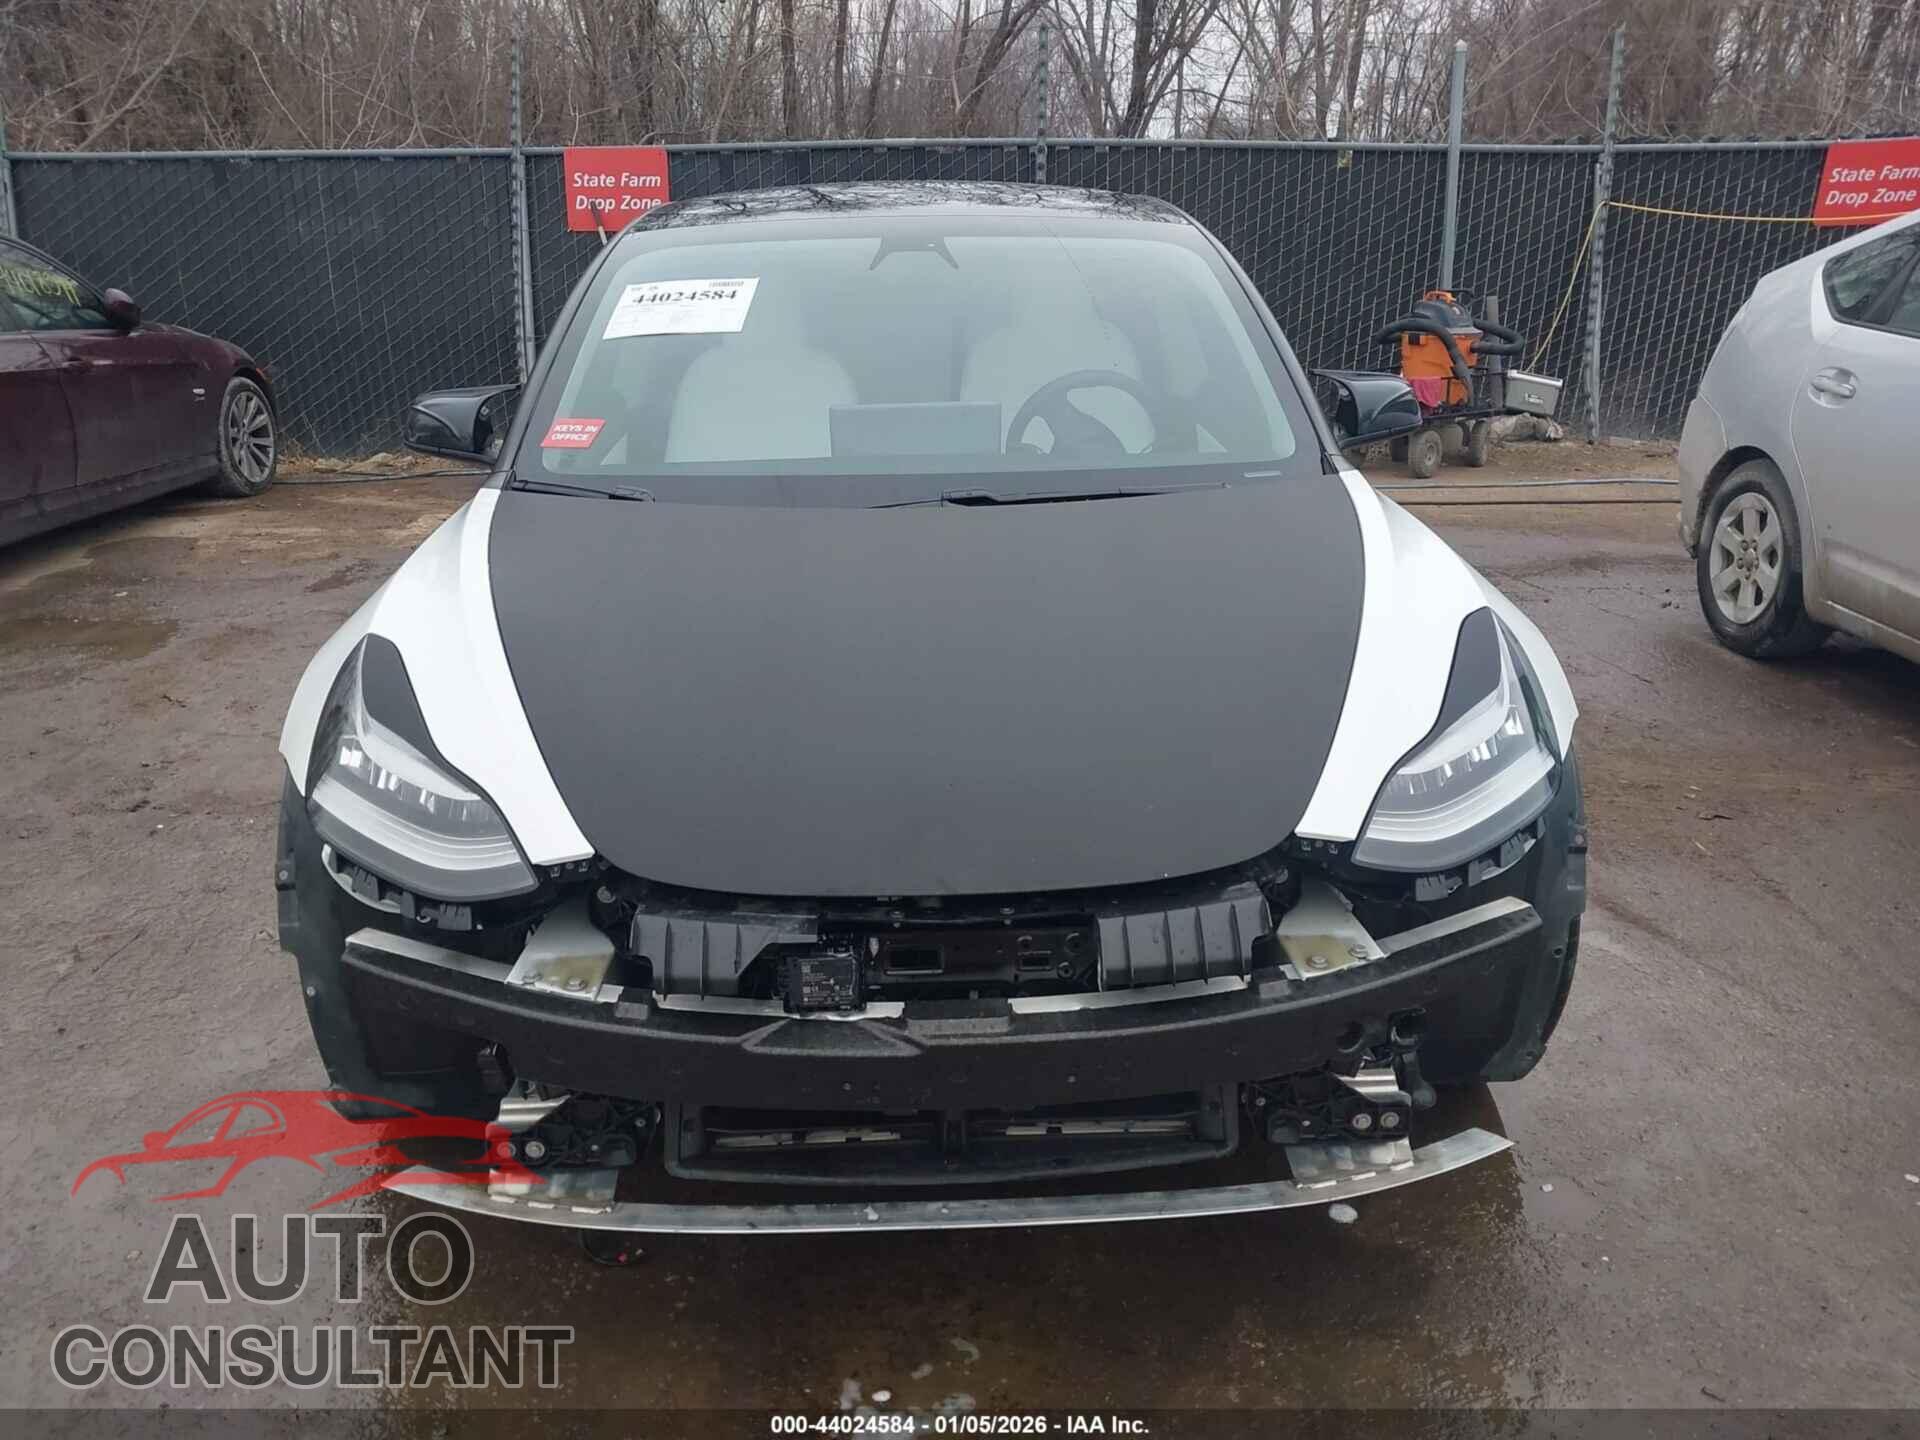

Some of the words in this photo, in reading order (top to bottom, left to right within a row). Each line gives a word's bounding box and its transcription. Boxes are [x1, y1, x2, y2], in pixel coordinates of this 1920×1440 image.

[573, 172, 616, 188] State
[620, 172, 661, 188] Farm
[1829, 168, 1876, 183] State
[1880, 165, 1920, 180] Farm
[575, 195, 616, 213] Drop
[620, 195, 662, 210] Zone
[1825, 190, 1869, 208] Drop
[1871, 188, 1917, 204] Zone
[632, 290, 738, 304] 44024584
[553, 424, 583, 432] KEYS
[551, 433, 590, 441] OFFICE
